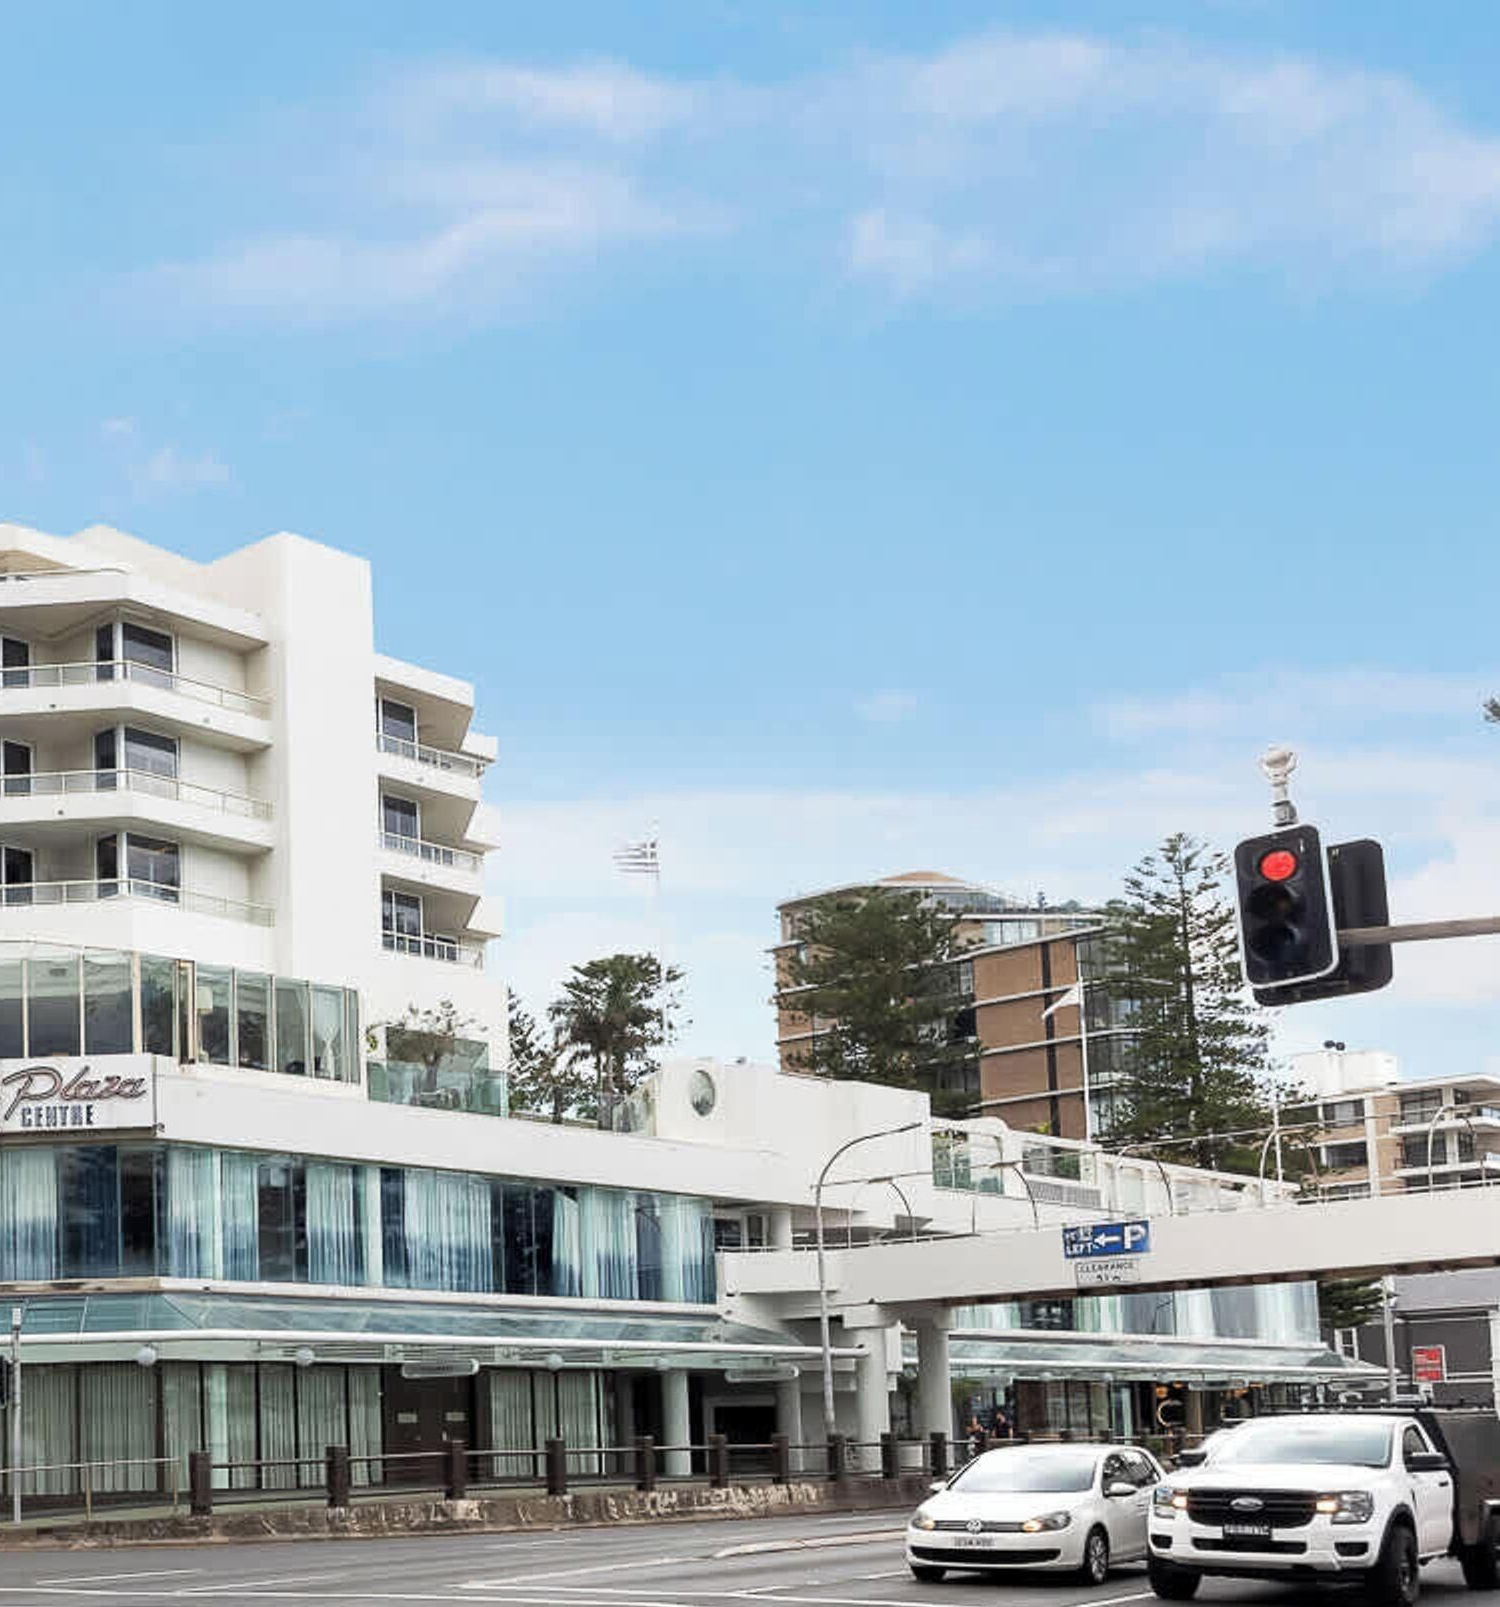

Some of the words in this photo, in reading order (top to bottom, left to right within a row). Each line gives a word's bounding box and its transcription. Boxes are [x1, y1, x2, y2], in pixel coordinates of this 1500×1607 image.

[2, 1065, 147, 1121] Plaza
[21, 1104, 94, 1128] CENTRE
[1124, 1225, 1145, 1249] P
